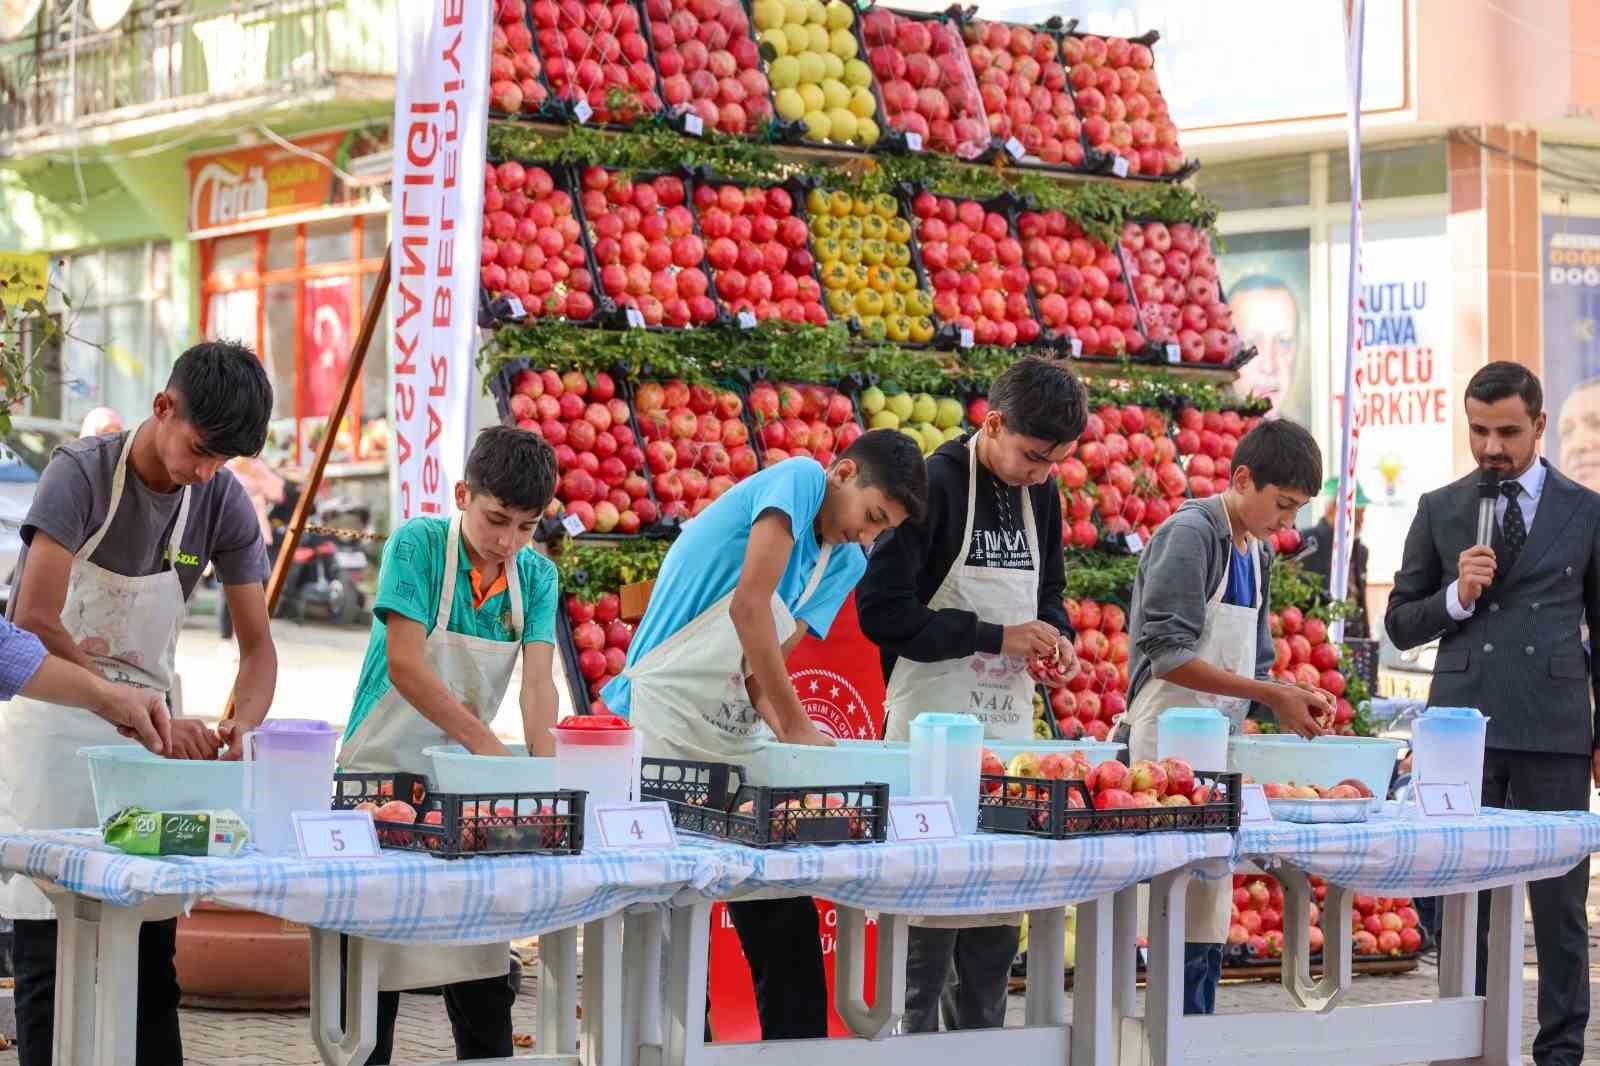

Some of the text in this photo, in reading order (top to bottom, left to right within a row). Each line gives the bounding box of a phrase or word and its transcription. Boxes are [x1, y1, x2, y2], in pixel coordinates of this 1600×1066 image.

[1363, 315, 1417, 347] DAVA
[969, 690, 1014, 711] NAR
[1442, 791, 1454, 810] 1
[630, 819, 645, 840] 4
[915, 812, 929, 833] 3
[330, 828, 346, 852] 5
